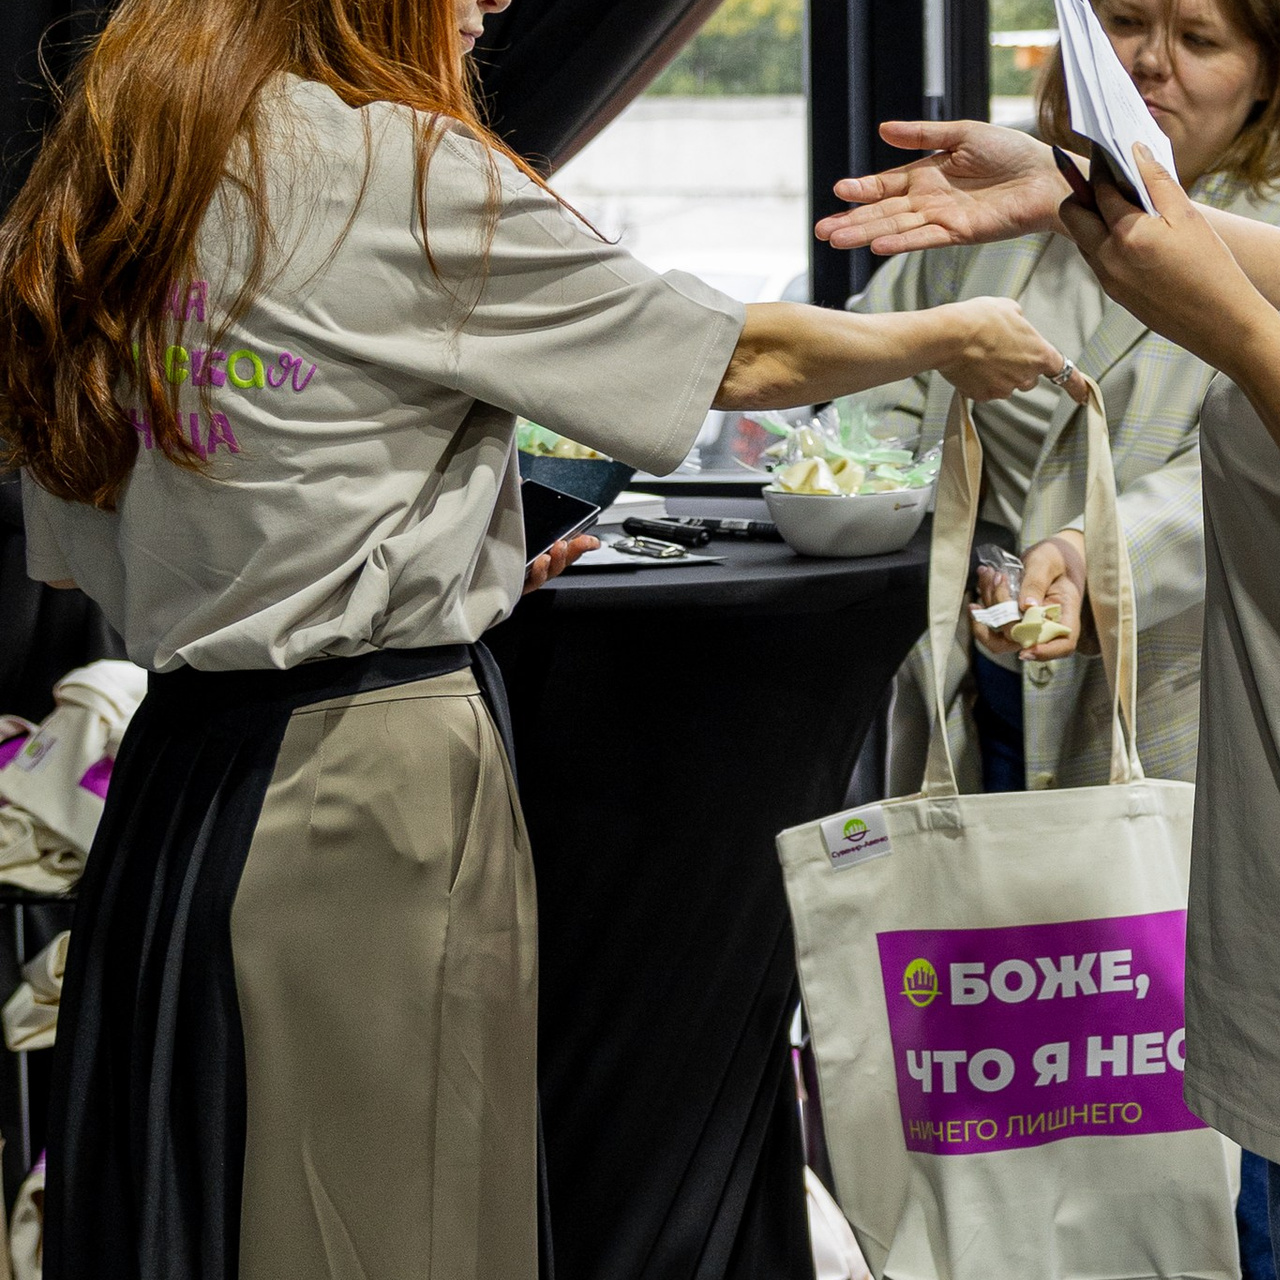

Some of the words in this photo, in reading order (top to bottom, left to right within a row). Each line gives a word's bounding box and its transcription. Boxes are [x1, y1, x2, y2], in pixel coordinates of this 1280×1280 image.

[949, 949, 1151, 1006] БОЖЕ,
[906, 1047, 1016, 1093] ЧТО
[1032, 1041, 1070, 1087] Я
[908, 1118, 998, 1143] НИЧЕГО
[1004, 1101, 1143, 1138] ЛИШНЕГО
